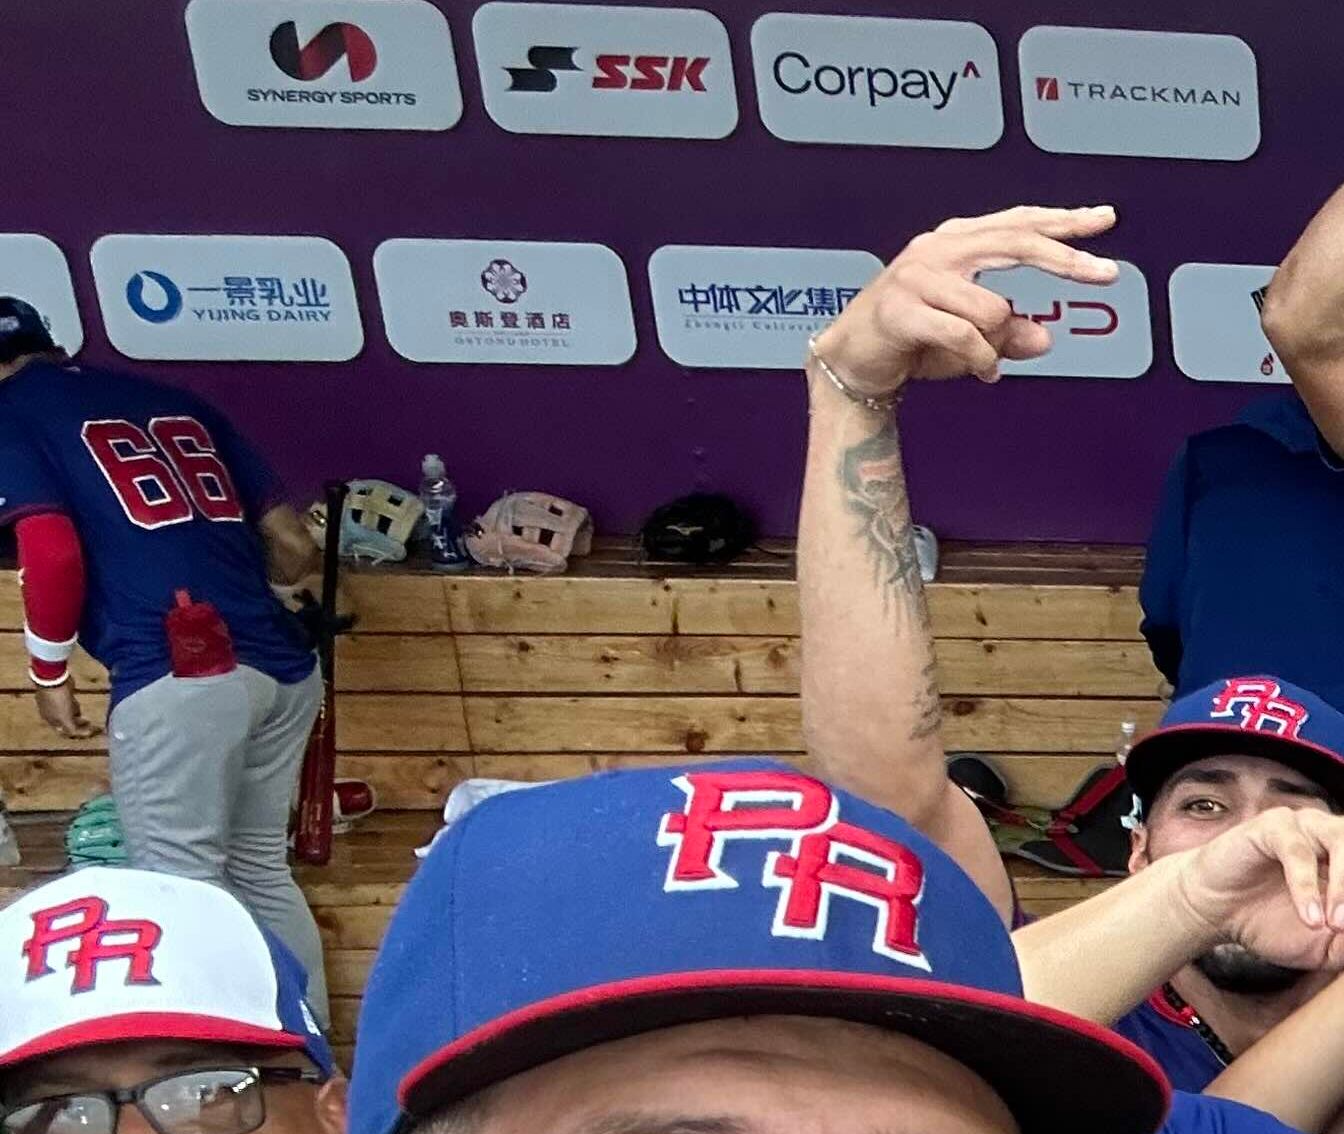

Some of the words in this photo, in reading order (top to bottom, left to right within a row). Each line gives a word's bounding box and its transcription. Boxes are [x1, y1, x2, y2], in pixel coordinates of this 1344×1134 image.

[592, 54, 711, 92] SSK
[248, 88, 337, 104] SYNERGY
[340, 91, 418, 106] SPORTS
[1067, 81, 1241, 106] TRACKMAN
[187, 276, 330, 307] 一景乳业
[266, 309, 331, 322] DAIRY
[81, 415, 244, 530] 66
[1210, 675, 1311, 742] PR
[656, 768, 932, 973] PR
[22, 895, 163, 995] PR
